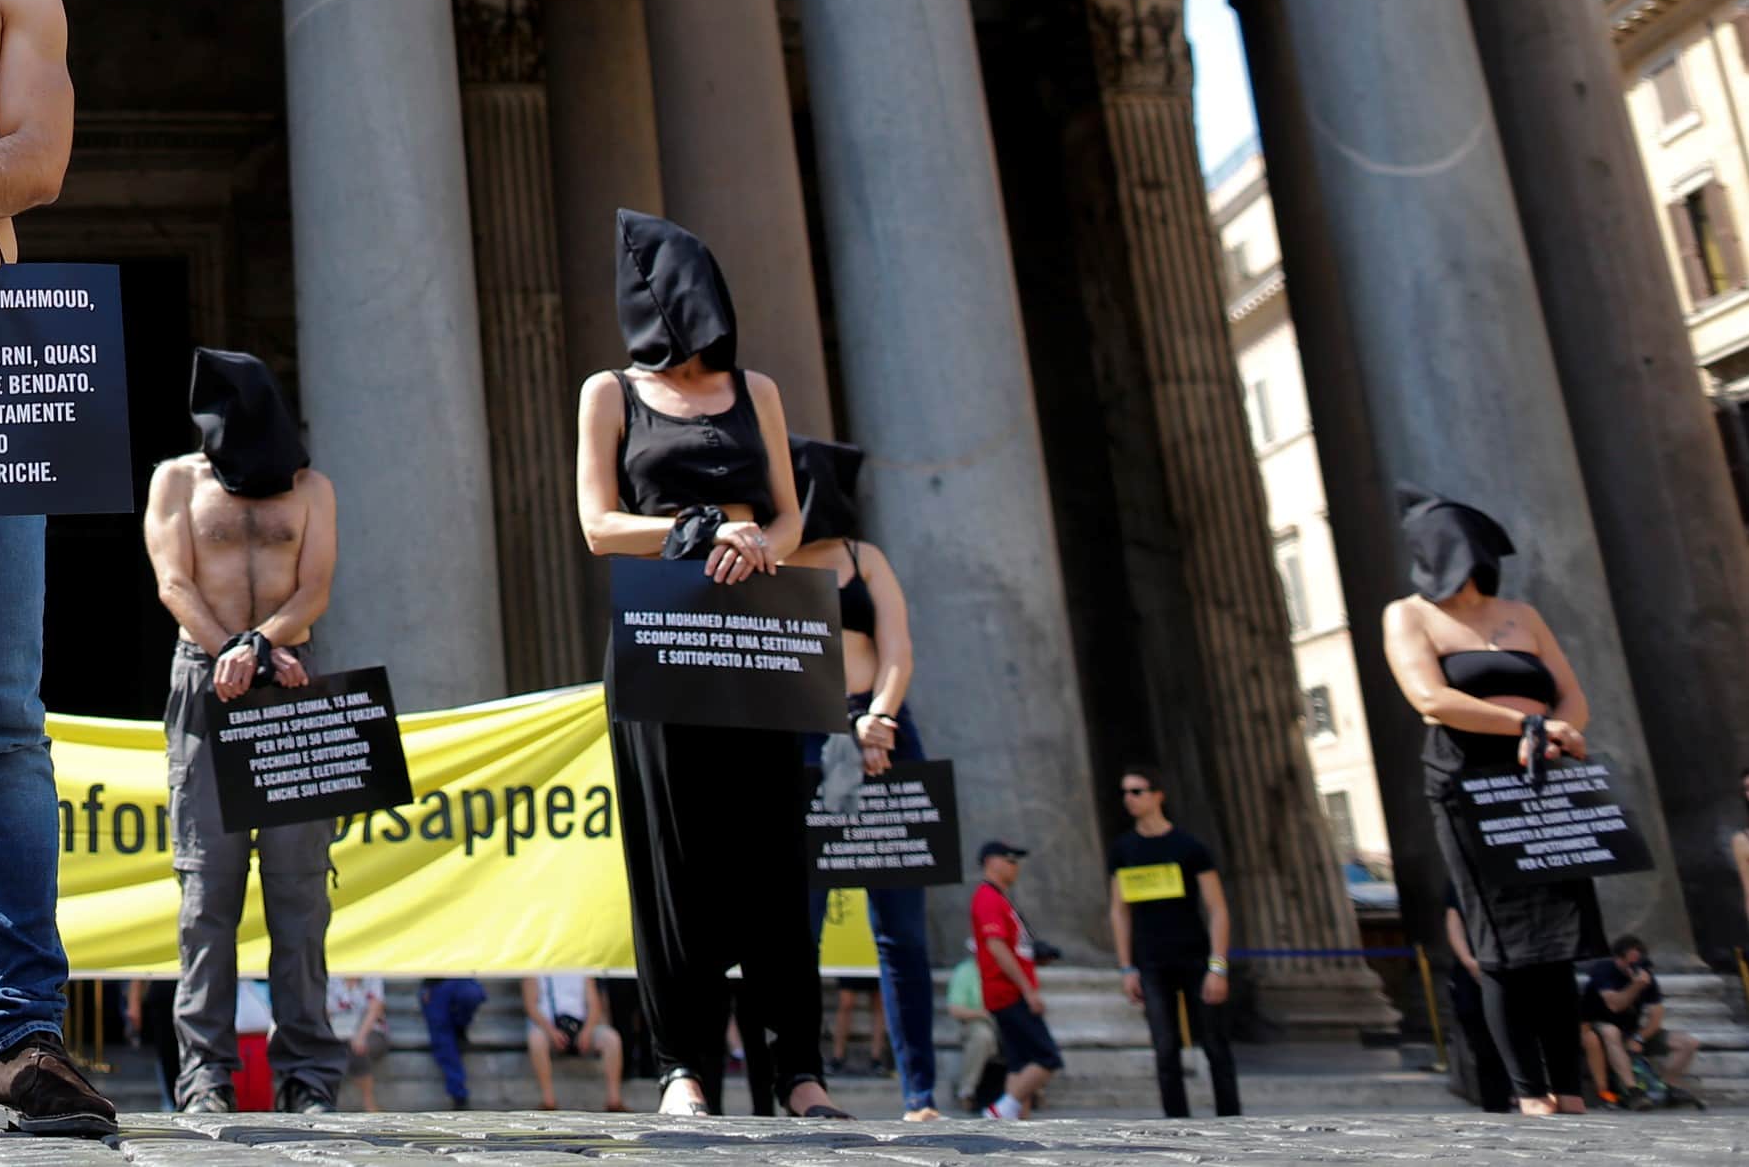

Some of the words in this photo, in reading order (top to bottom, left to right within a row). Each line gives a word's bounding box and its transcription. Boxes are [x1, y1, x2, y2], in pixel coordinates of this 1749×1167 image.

[0, 289, 94, 311] MAHMOUD,
[44, 344, 97, 366] QUASI
[8, 372, 95, 395] BENDATO.
[624, 612, 663, 625] MAZEN
[666, 613, 722, 628] MOHAMED
[725, 616, 783, 633] ABDALLAH,
[787, 620, 799, 633] 14
[635, 630, 707, 646] SCOMPARSO
[710, 634, 733, 647] PER
[736, 636, 759, 649] UNA
[762, 637, 822, 654] SETTIMANA
[659, 650, 666, 663] E
[669, 650, 742, 667] SOTTOPOSTO
[745, 655, 752, 668] A
[755, 655, 802, 671] STUPRO.
